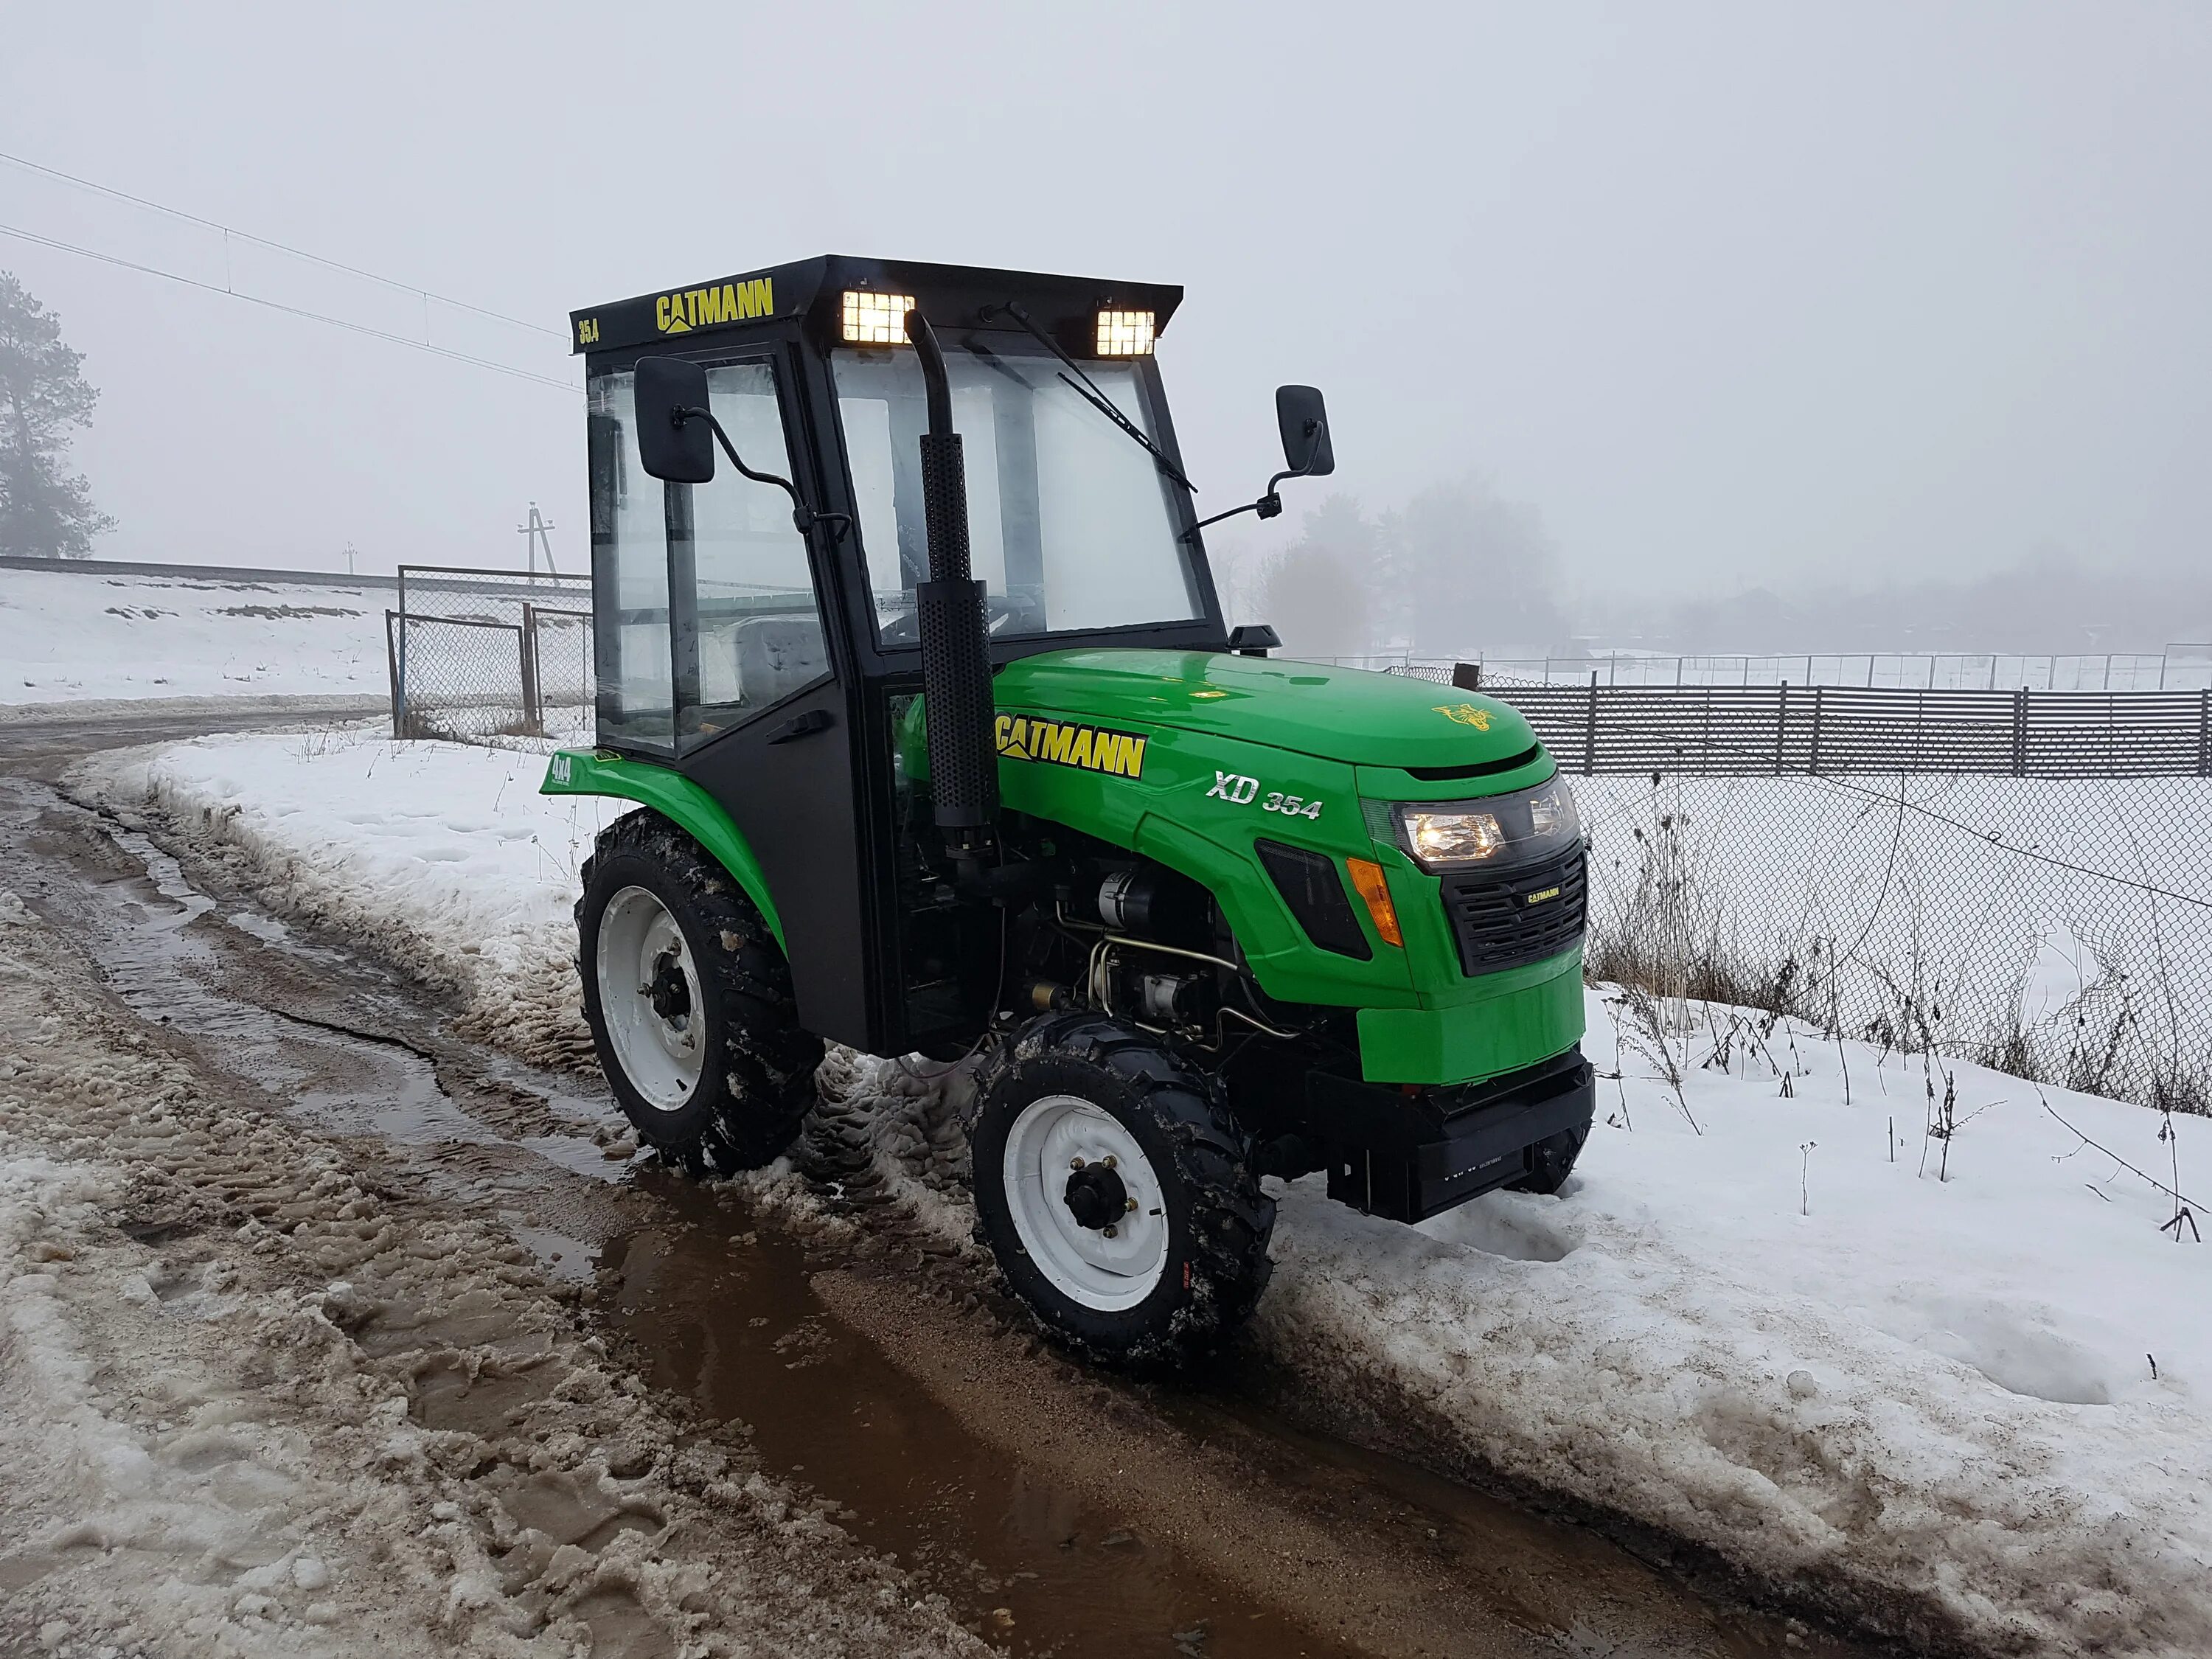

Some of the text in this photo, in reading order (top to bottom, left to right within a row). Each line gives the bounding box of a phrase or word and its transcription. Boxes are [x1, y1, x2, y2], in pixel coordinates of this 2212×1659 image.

[656, 277, 773, 334] CATMANN
[995, 715, 1145, 777] CATMANN
[1205, 771, 1323, 820] XD 354
[1528, 887, 1559, 903] CATMANN
